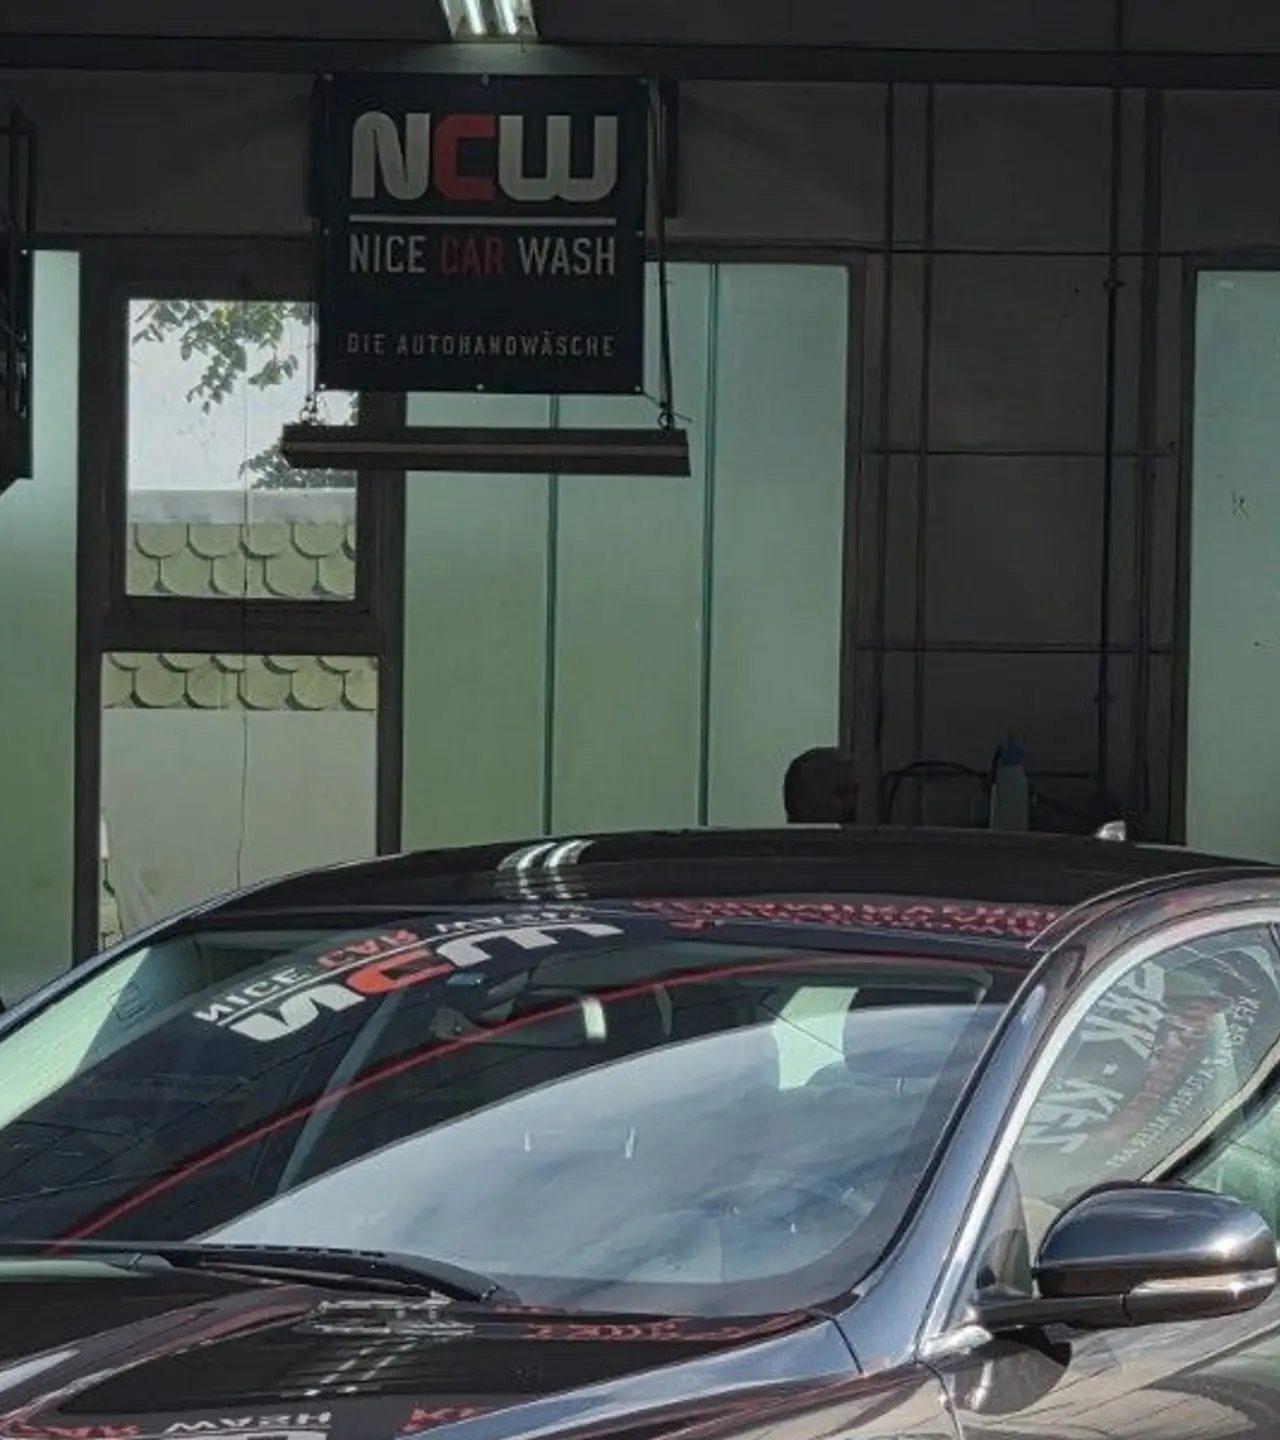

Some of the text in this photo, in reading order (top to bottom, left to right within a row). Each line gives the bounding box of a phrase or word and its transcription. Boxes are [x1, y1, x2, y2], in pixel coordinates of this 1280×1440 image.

[350, 110, 618, 201] NCW
[349, 234, 616, 276] NICE CAR WASH
[346, 330, 618, 357] DIE AUTOHANDWÄSCHE
